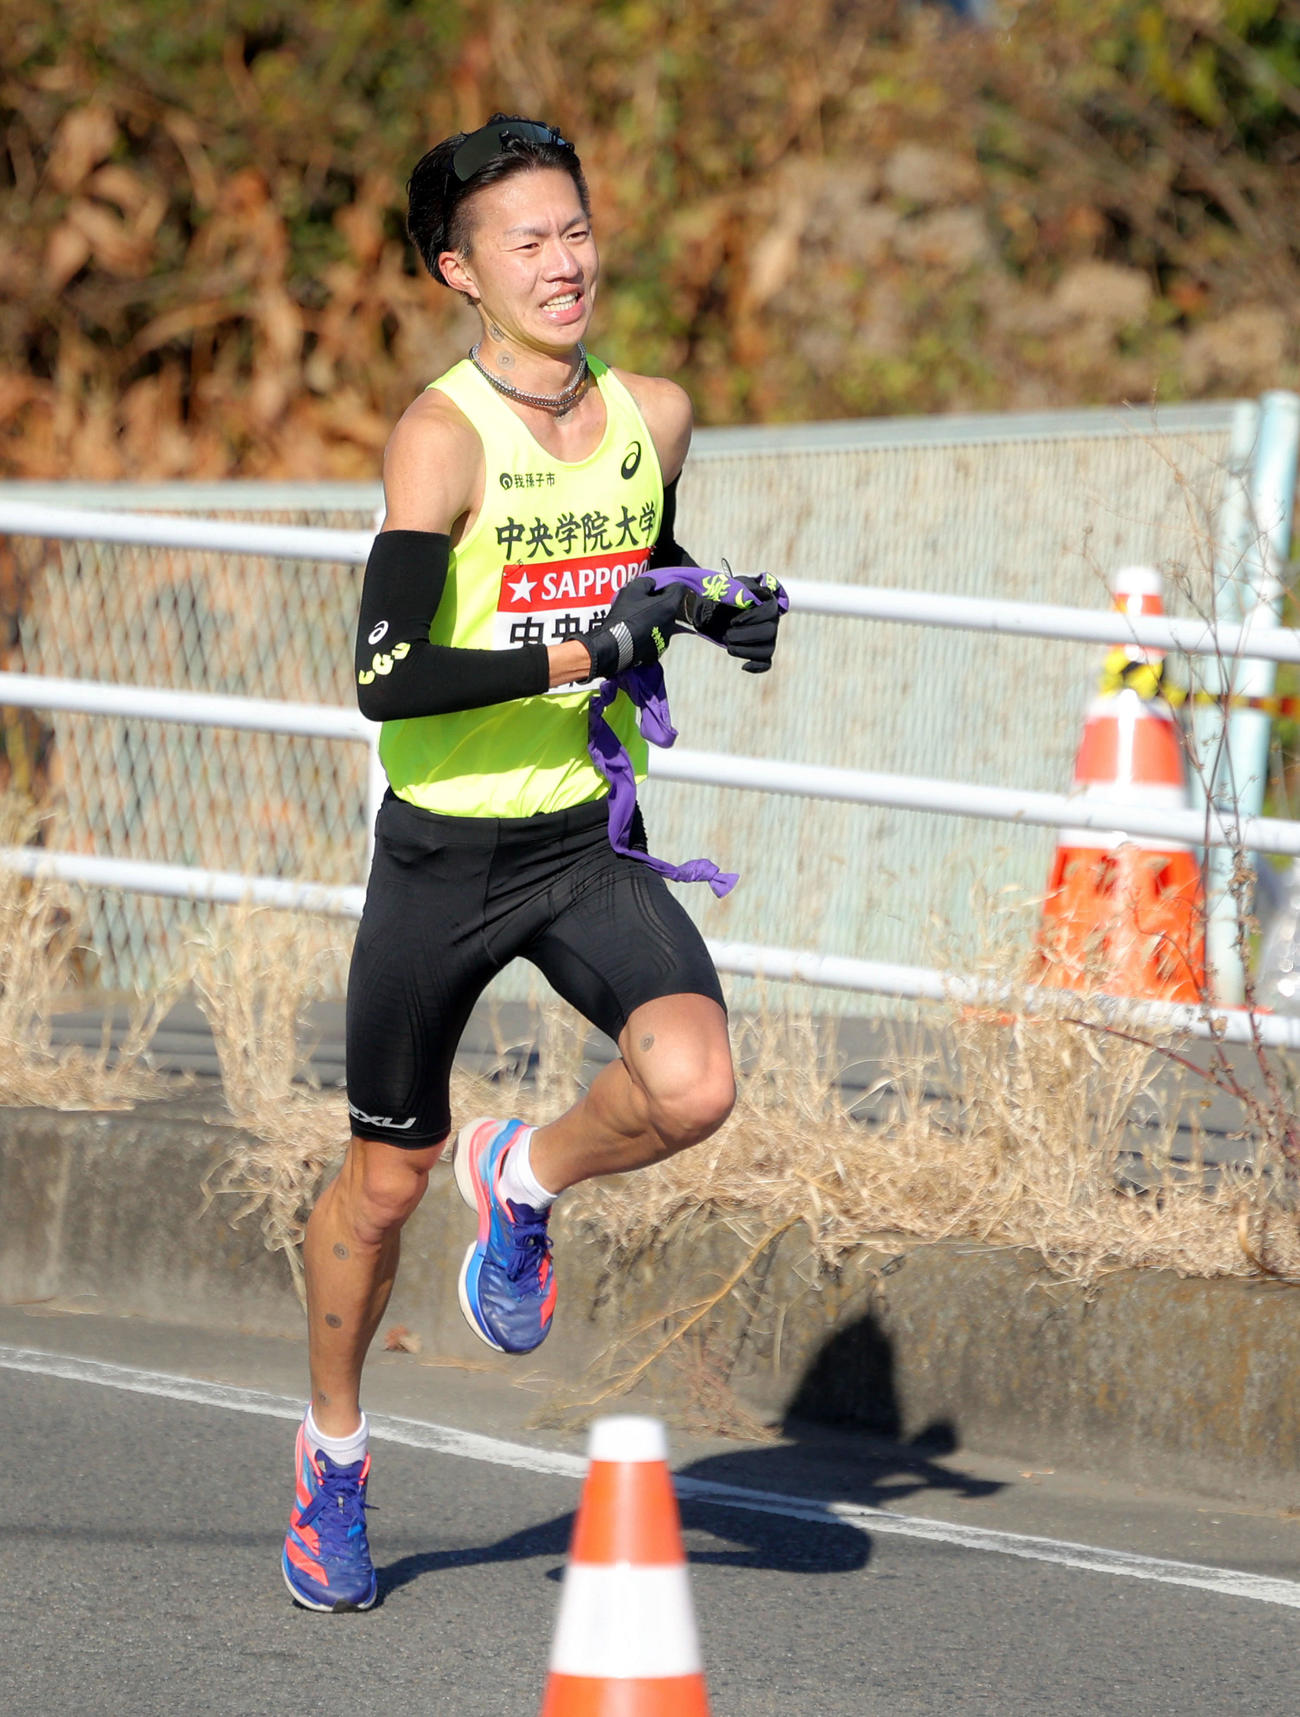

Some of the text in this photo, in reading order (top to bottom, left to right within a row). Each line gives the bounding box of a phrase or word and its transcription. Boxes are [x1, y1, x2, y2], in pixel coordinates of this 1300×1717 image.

[514, 472, 556, 489] 我孫子市
[495, 501, 656, 561] 中央学院大学
